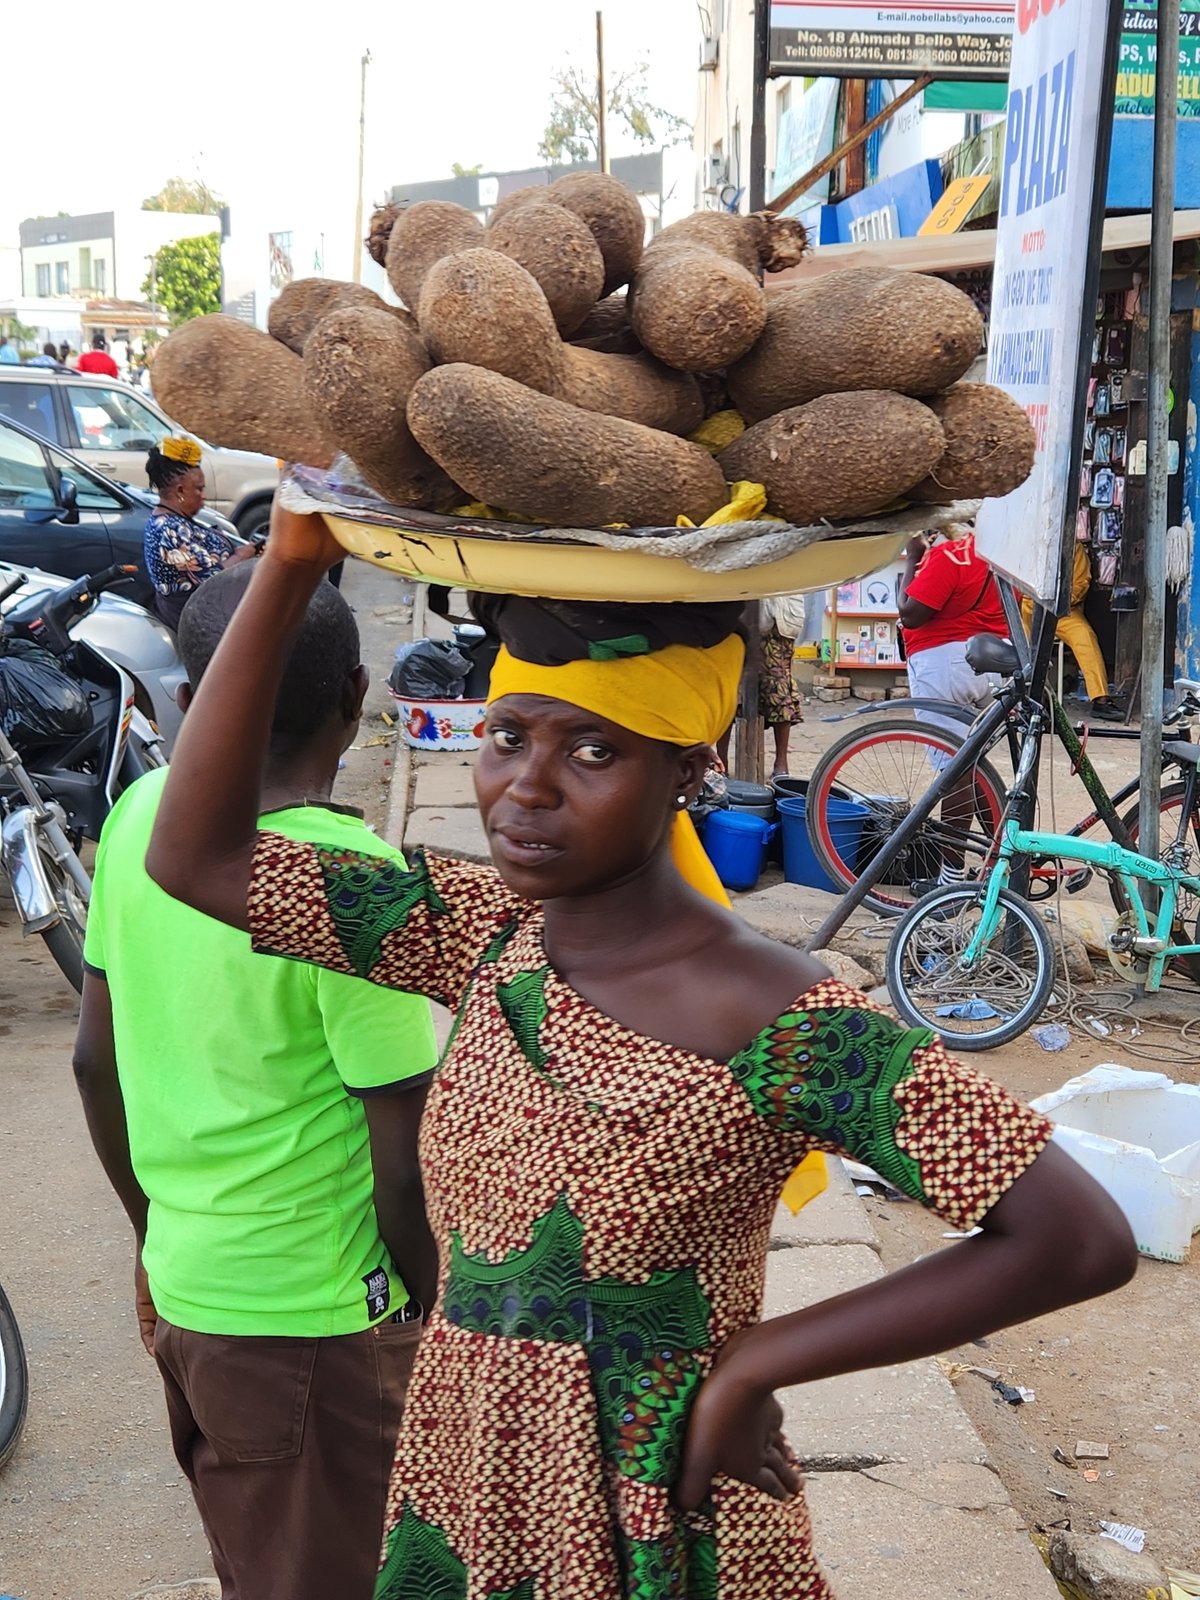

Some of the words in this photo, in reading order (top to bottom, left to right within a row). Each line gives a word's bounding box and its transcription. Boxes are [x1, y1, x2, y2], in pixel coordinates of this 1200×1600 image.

[785, 46, 808, 57] Tell:
[809, 46, 884, 60] 08068112416,
[797, 30, 822, 43] No.
[827, 31, 846, 43] 18
[849, 32, 911, 46] Ahmadu
[915, 34, 953, 47] Bello
[956, 35, 991, 50] Way,
[1000, 49, 1076, 217] PLAZA
[935, 181, 974, 230] POCO
[1010, 269, 1026, 307] GOD
